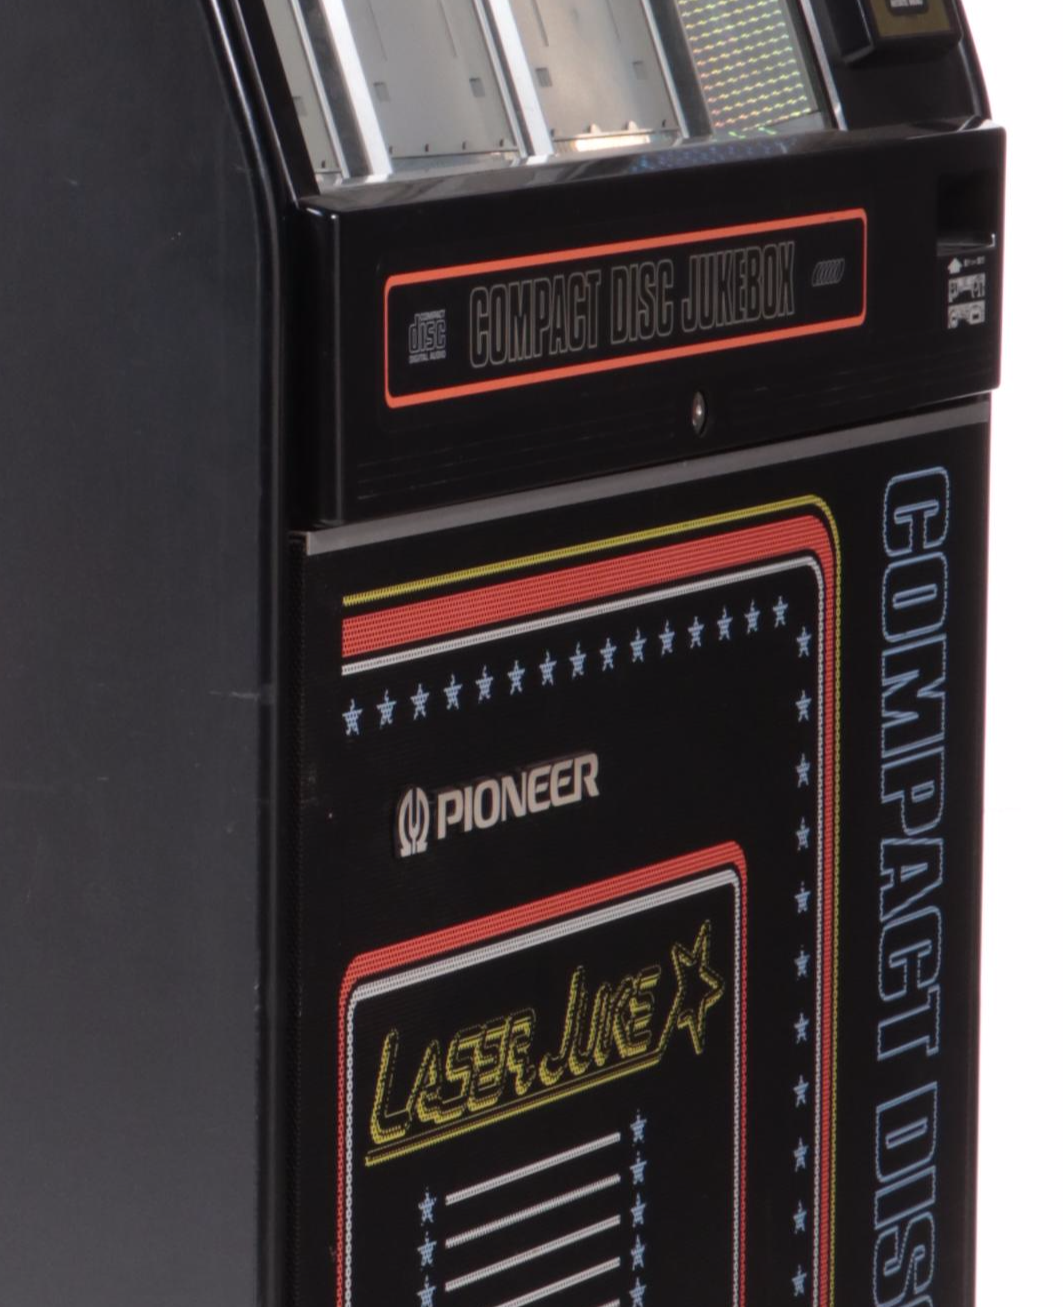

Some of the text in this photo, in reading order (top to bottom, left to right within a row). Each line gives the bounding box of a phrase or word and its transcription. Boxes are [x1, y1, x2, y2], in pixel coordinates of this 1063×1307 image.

[408, 313, 447, 354] disc
[419, 309, 446, 321] COMPACT
[469, 240, 796, 369] COMPACT DISC JUKEBOX
[436, 752, 600, 841] PIONEER
[875, 464, 951, 1062] COMPACT
[369, 964, 662, 1146] LASER JUKE
